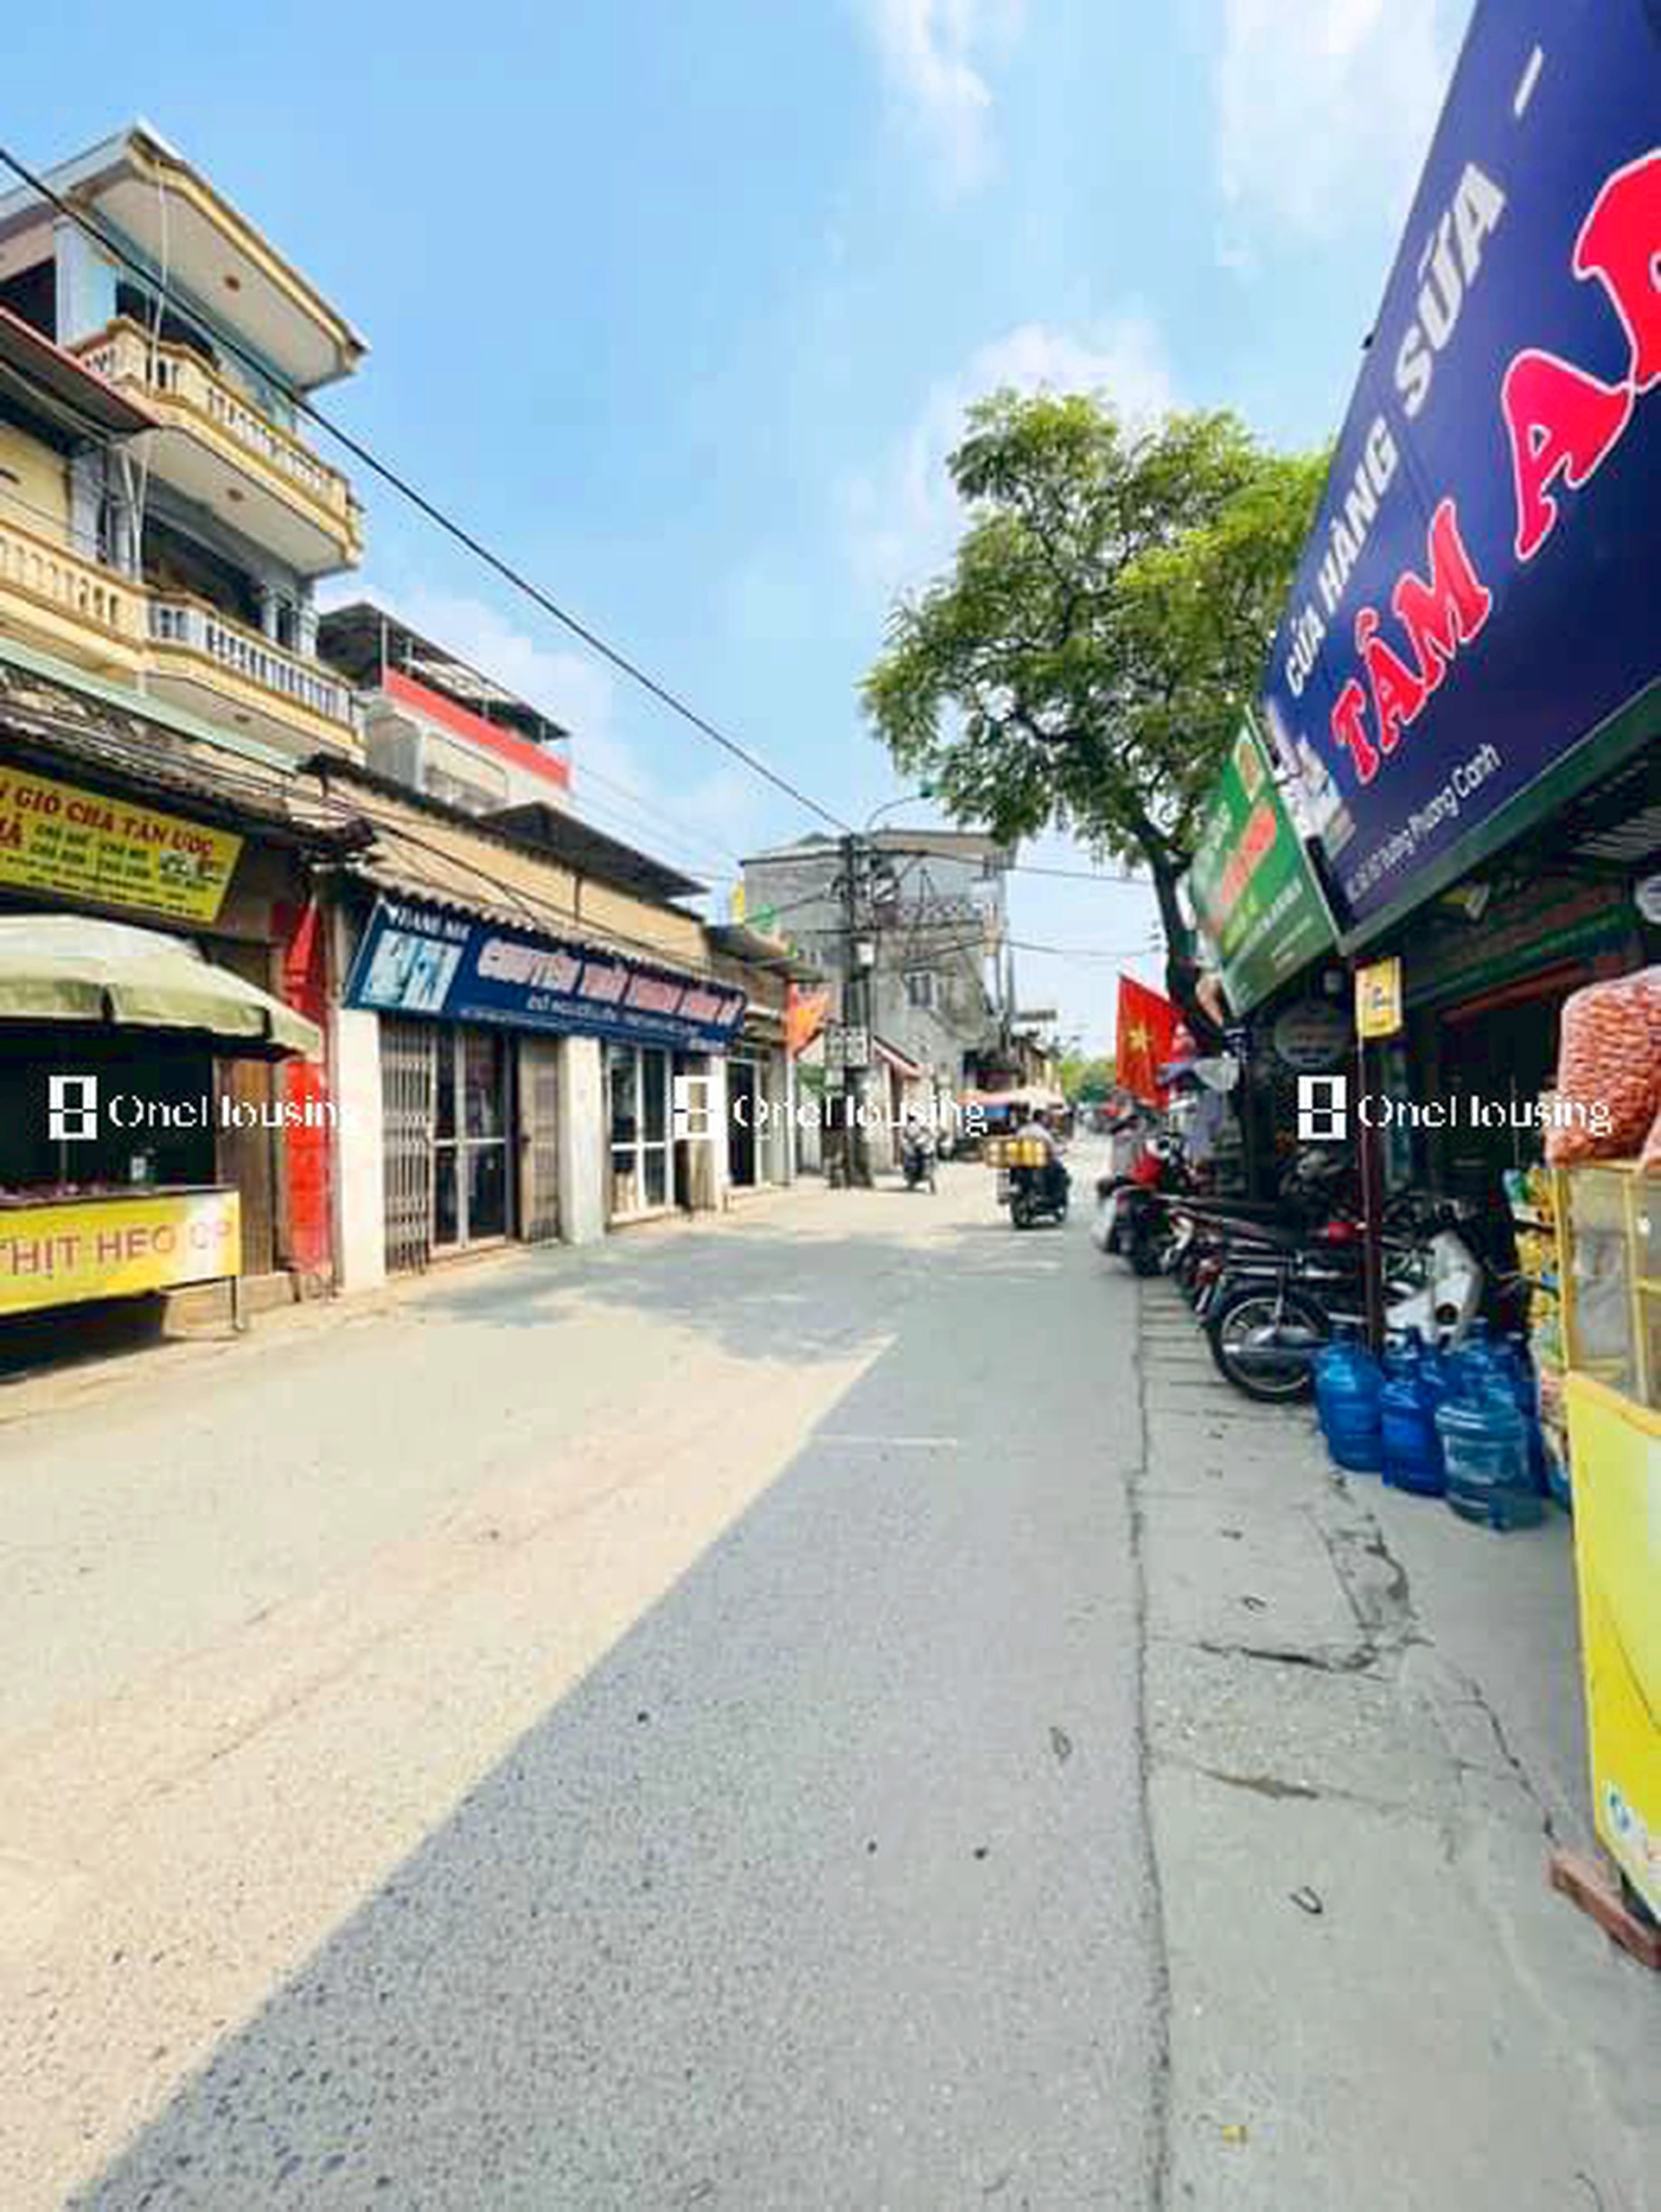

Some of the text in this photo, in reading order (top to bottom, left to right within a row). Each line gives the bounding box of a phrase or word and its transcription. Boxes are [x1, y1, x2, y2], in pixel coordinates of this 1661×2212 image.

[1318, 417, 1399, 615] HÀNG
[1395, 162, 1506, 418] SỮA
[97, 1224, 177, 1264] HEO
